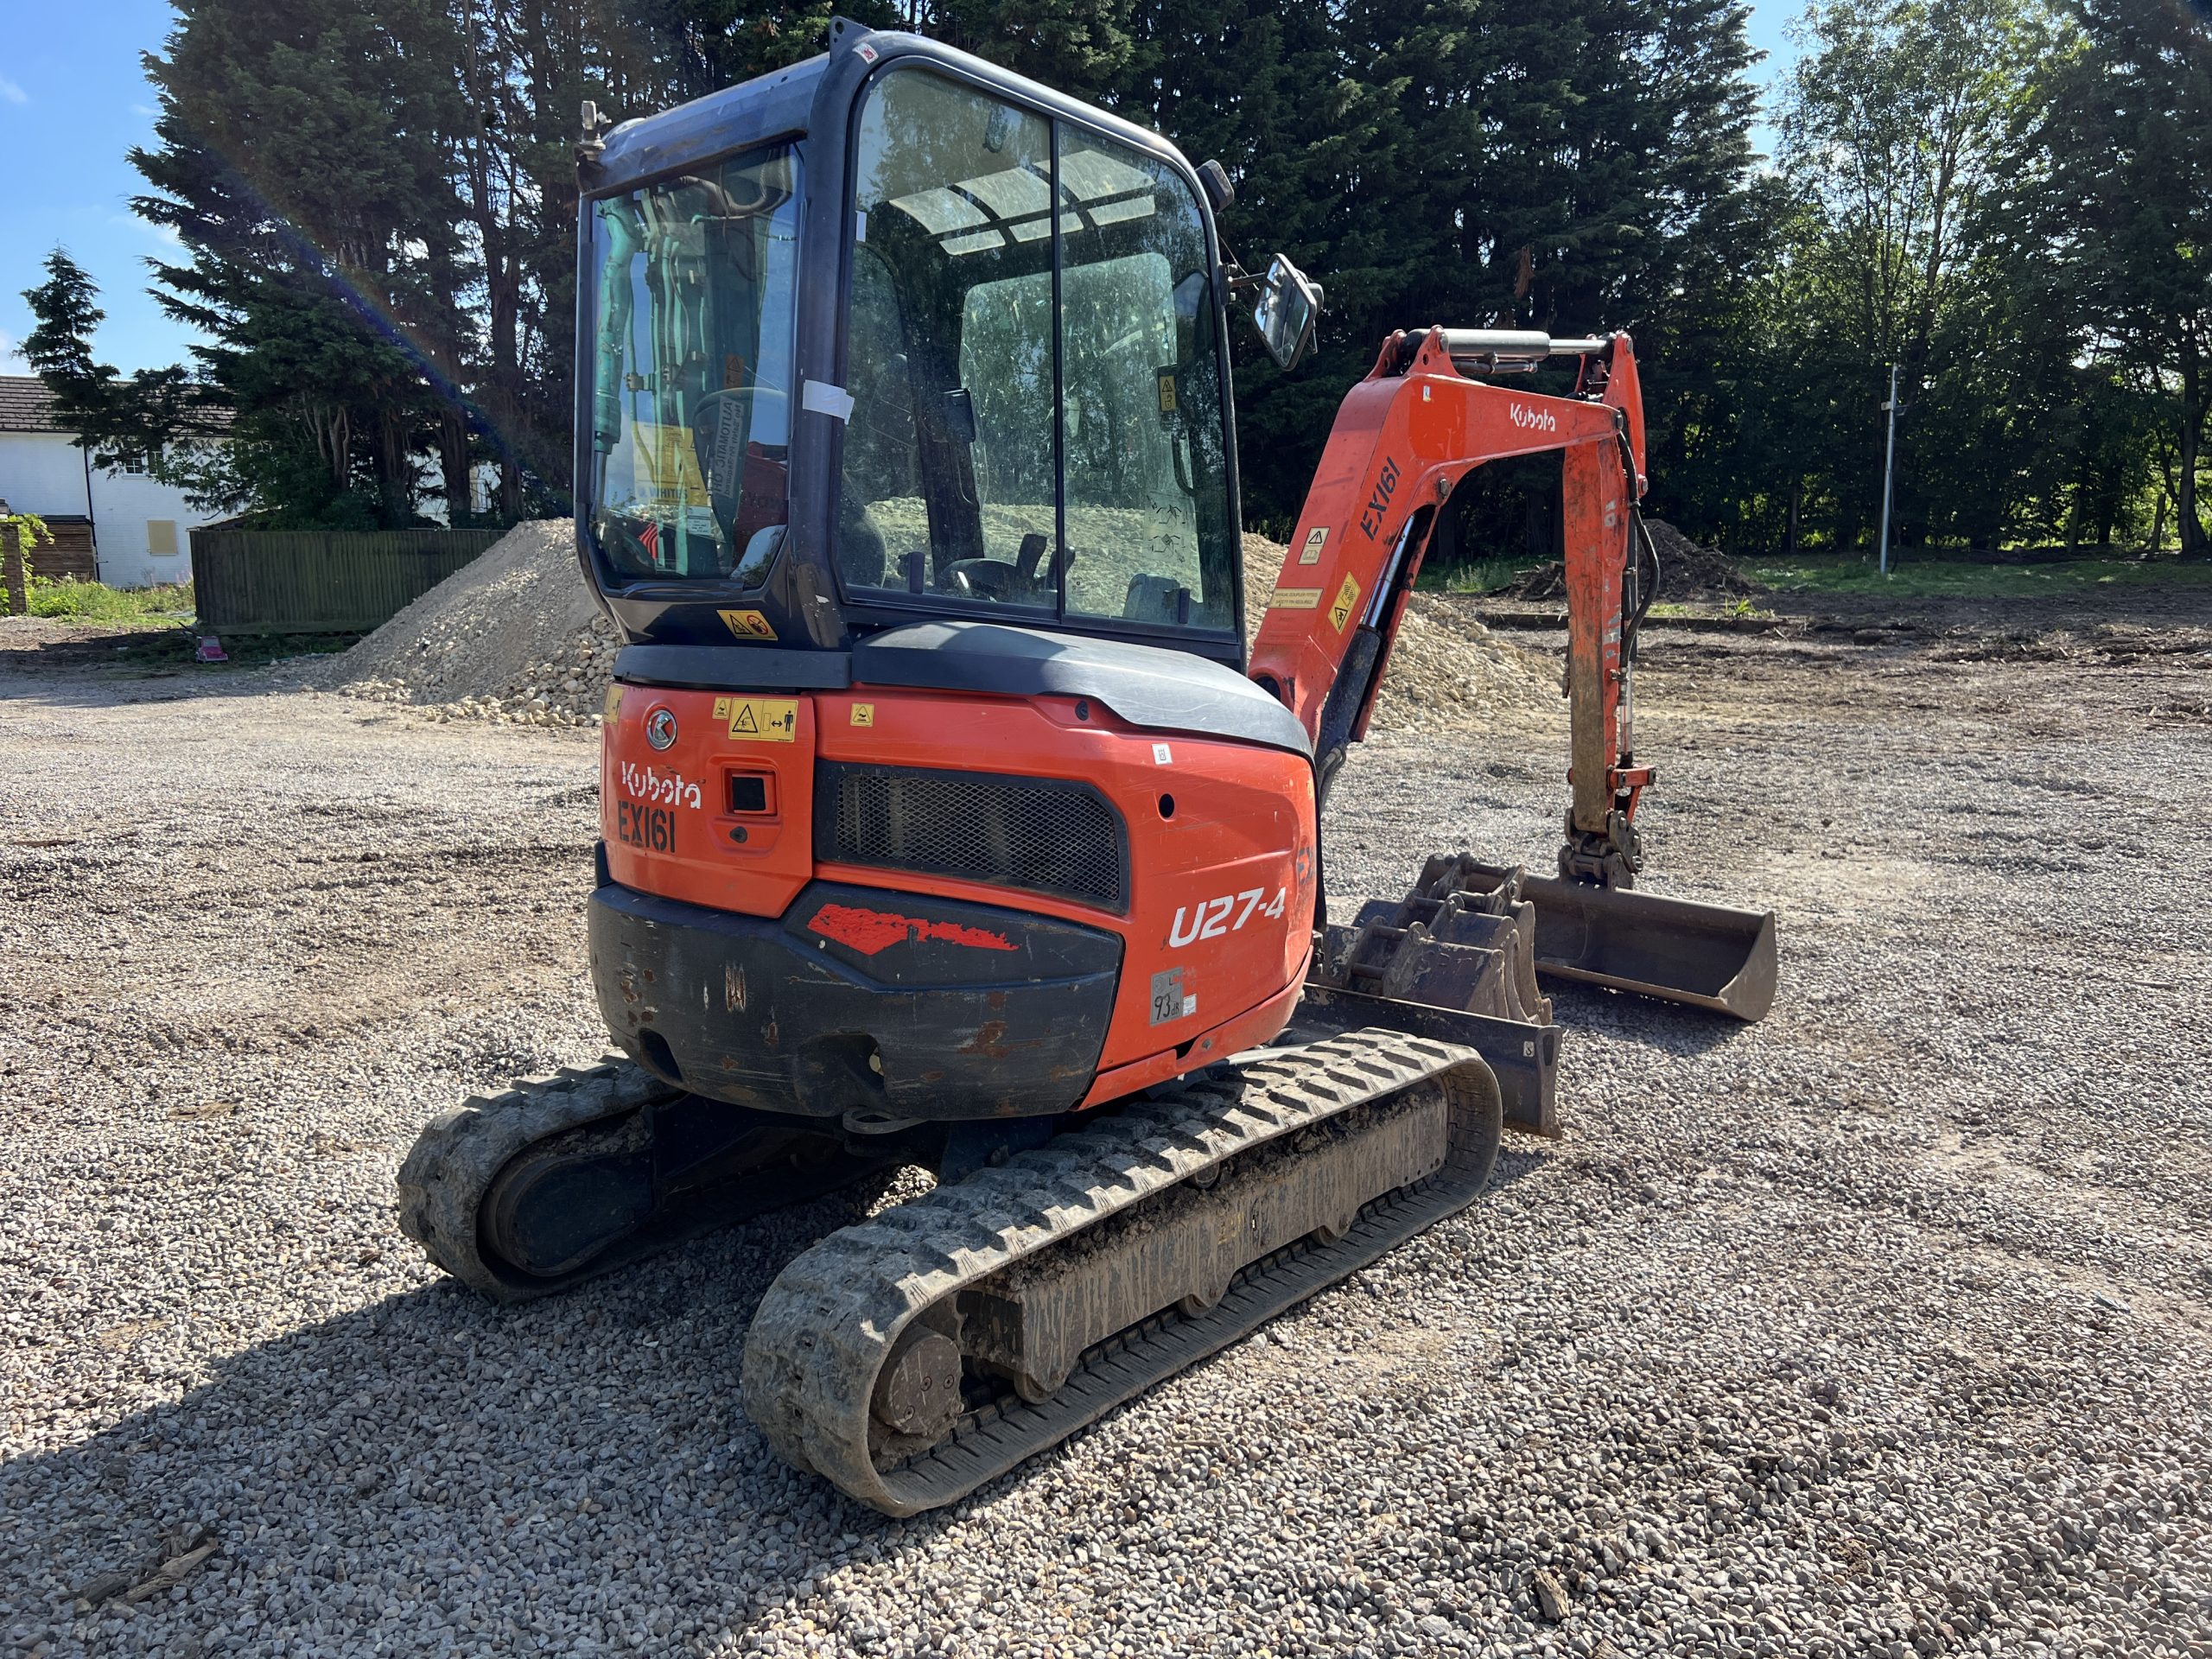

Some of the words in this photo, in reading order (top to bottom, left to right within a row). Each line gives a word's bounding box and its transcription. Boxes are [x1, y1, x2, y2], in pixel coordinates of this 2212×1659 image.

[1510, 403, 1556, 432] Kubota
[1360, 455, 1401, 541] EX161
[621, 760, 702, 809] Kubota
[618, 800, 676, 854] EX161
[1168, 887, 1287, 948] U27-4
[1154, 993, 1171, 1020] 93
